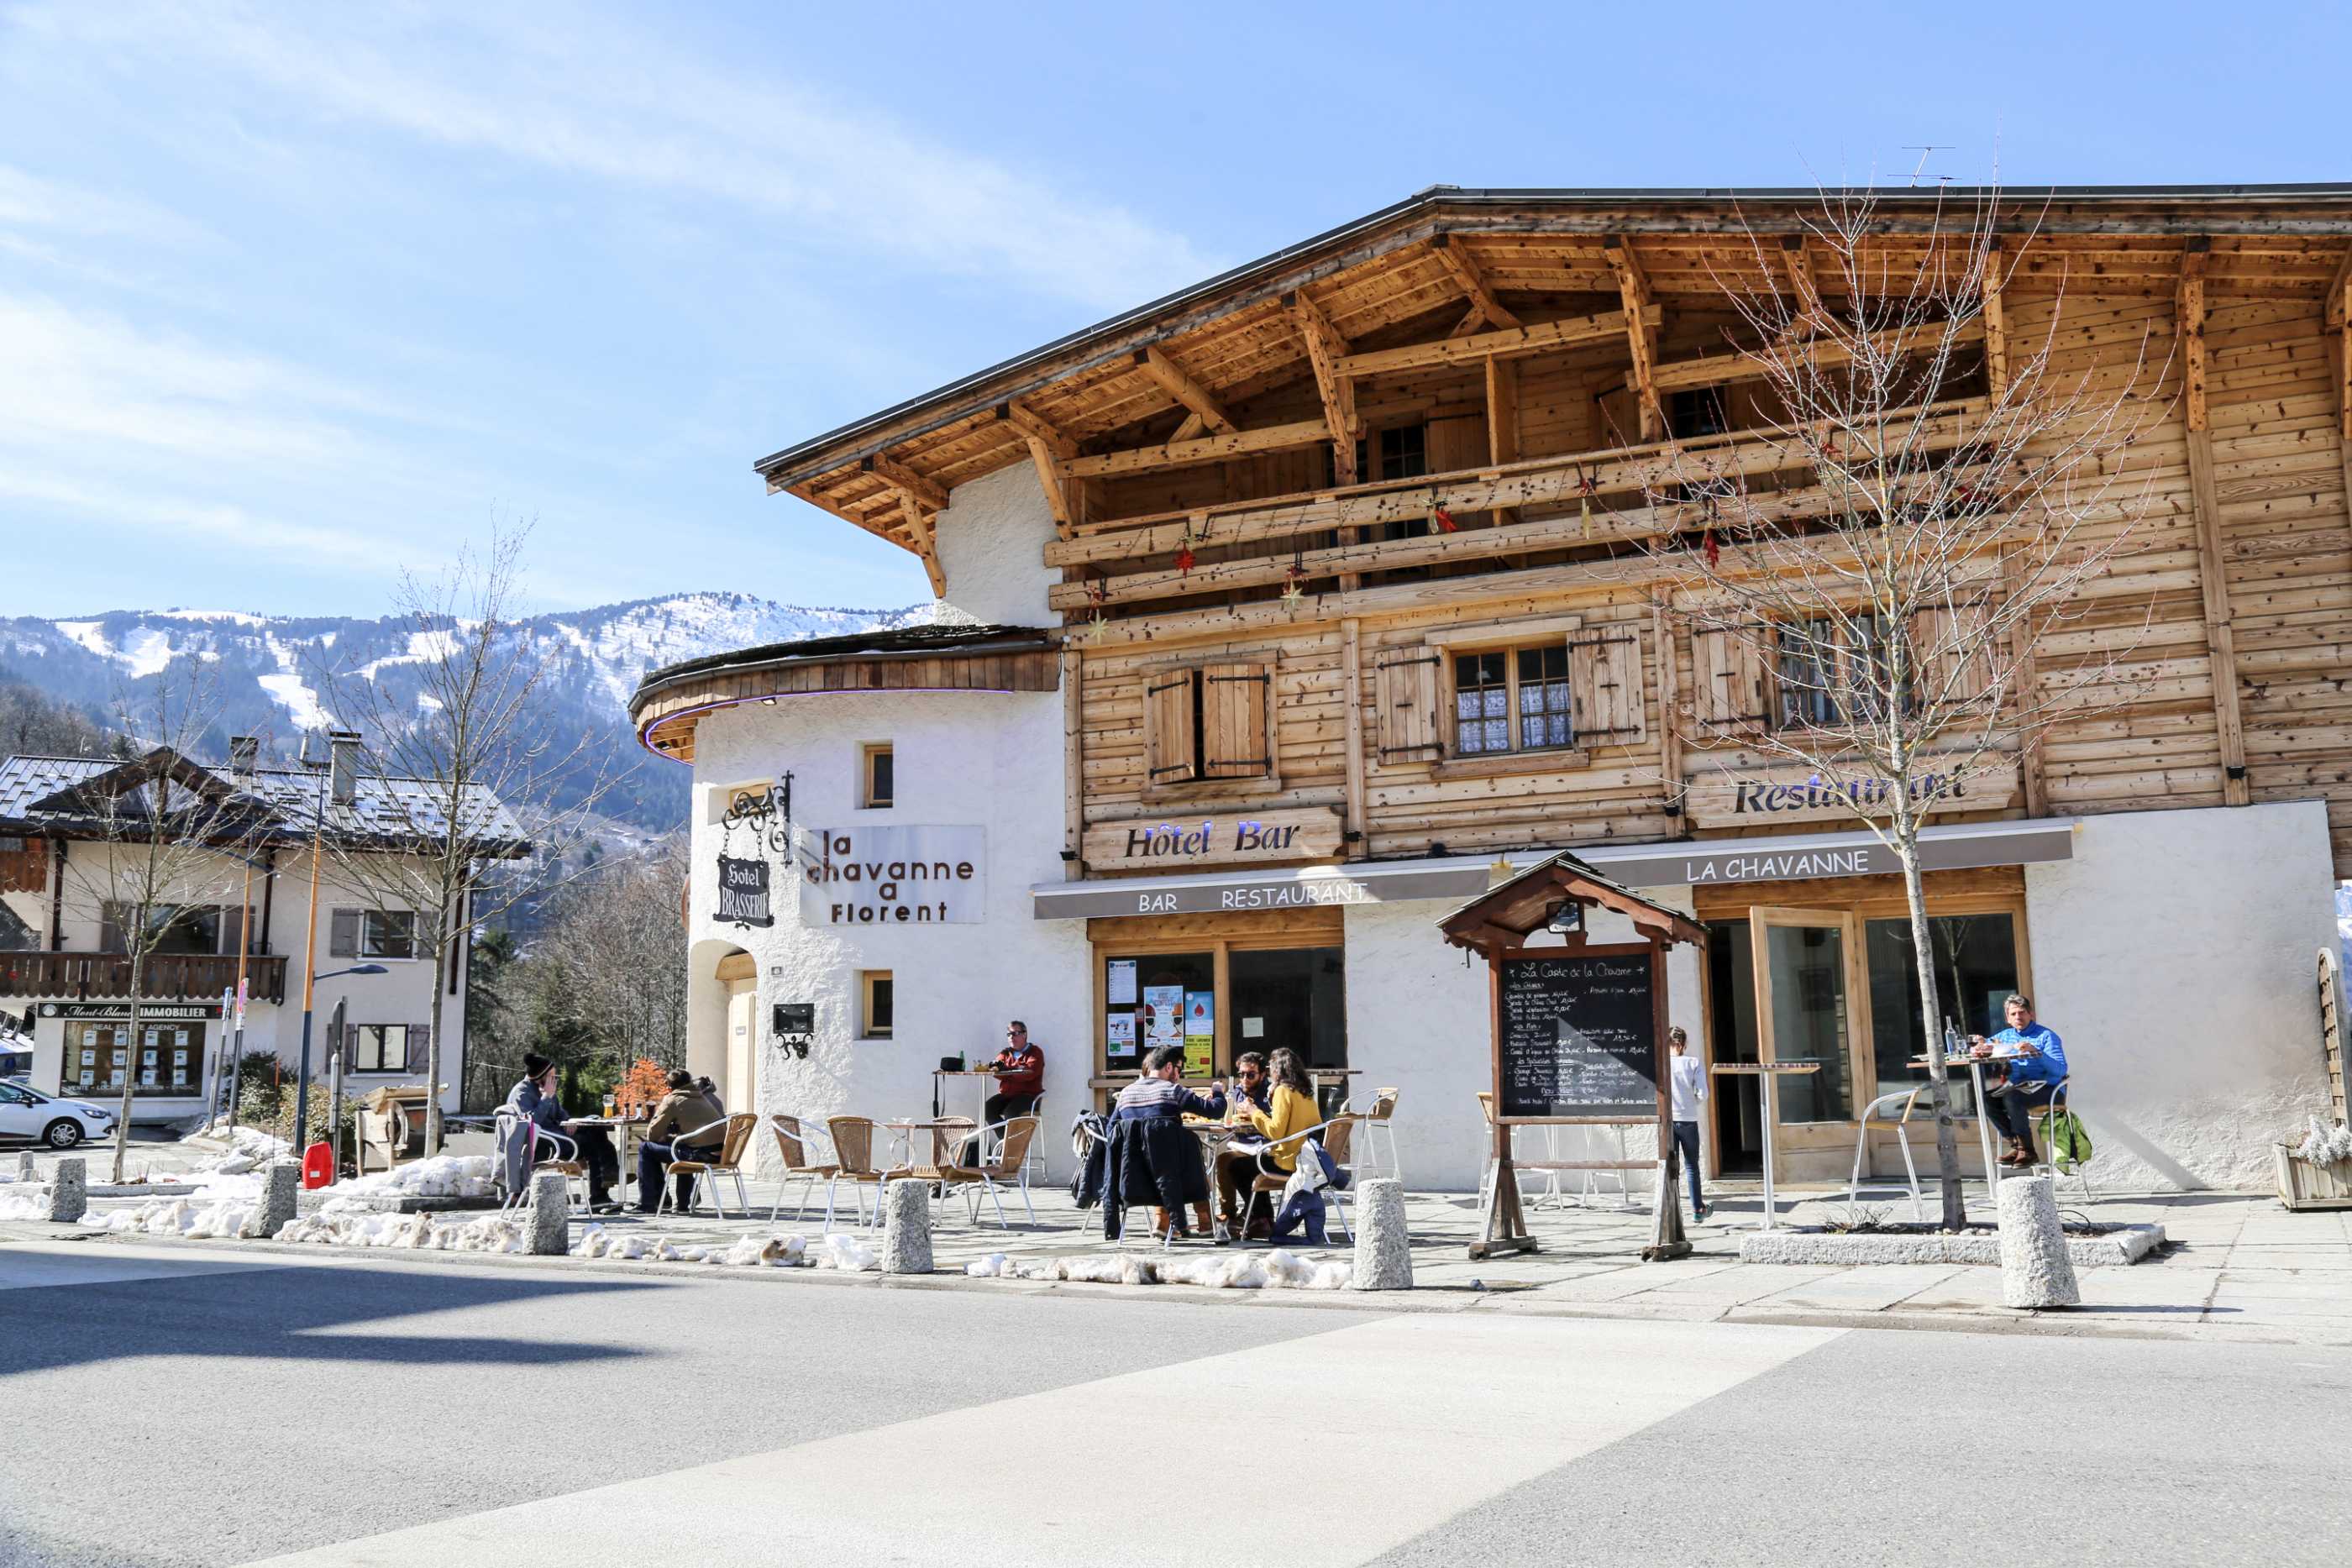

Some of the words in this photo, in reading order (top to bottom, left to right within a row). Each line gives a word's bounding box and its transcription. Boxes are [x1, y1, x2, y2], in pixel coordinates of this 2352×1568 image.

[822, 830, 851, 856] la
[1125, 821, 1213, 857] Hôtel
[1234, 820, 1300, 852] Bar
[727, 863, 760, 887] Hotel
[806, 857, 974, 884] chavanne
[1687, 861, 1716, 882] LA
[1725, 850, 1869, 879] CHAVANNE
[721, 885, 769, 919] BRASSERIE
[1138, 894, 1178, 912] BAR
[1221, 883, 1368, 909] RESTAURANT
[831, 901, 948, 923] Florent
[1520, 962, 1538, 978] La
[1540, 962, 1568, 978] Carte
[1583, 963, 1593, 978] la
[139, 1007, 207, 1017] IMMOBILIER
[147, 1023, 181, 1031] AGENCY
